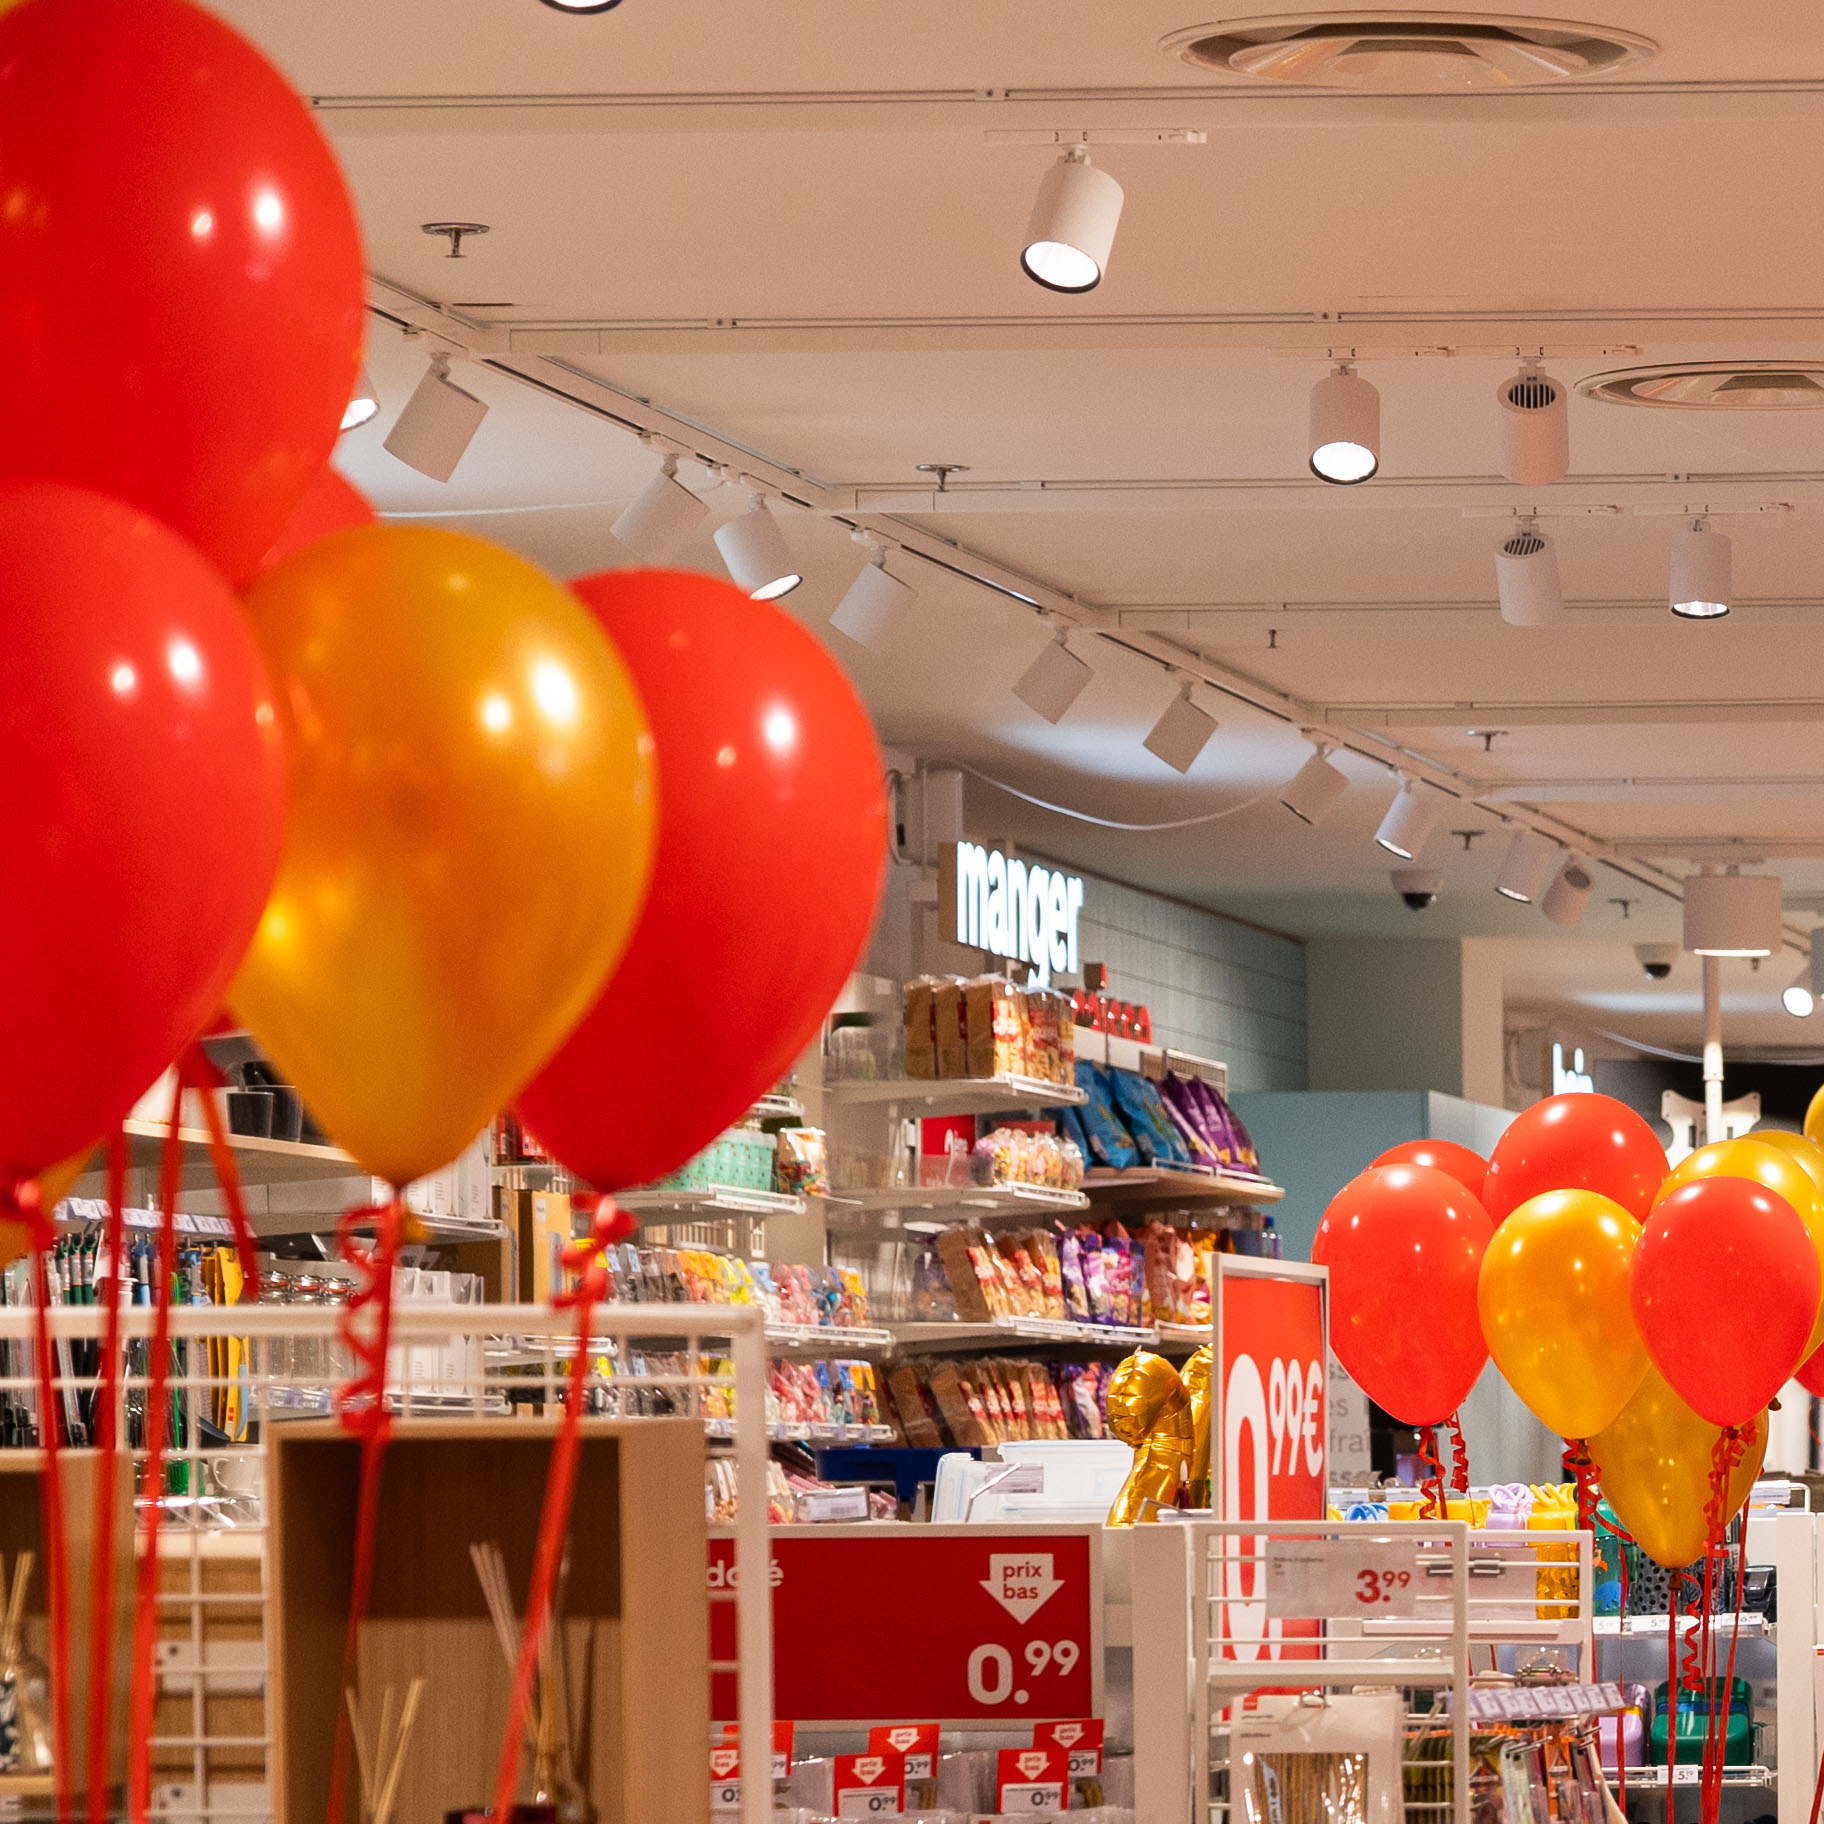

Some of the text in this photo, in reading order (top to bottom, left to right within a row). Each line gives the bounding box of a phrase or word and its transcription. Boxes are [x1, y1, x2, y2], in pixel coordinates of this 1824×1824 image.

[957, 840, 1084, 988] manger
[706, 1559, 785, 1588] dé
[1002, 1560, 1042, 1582] prix
[1003, 1582, 1039, 1600] bas
[1355, 1568, 1411, 1604] 3.99
[967, 1639, 1080, 1705] 0.99
[868, 1796, 897, 1812] 0.99
[1031, 1791, 1059, 1806] 0.99
